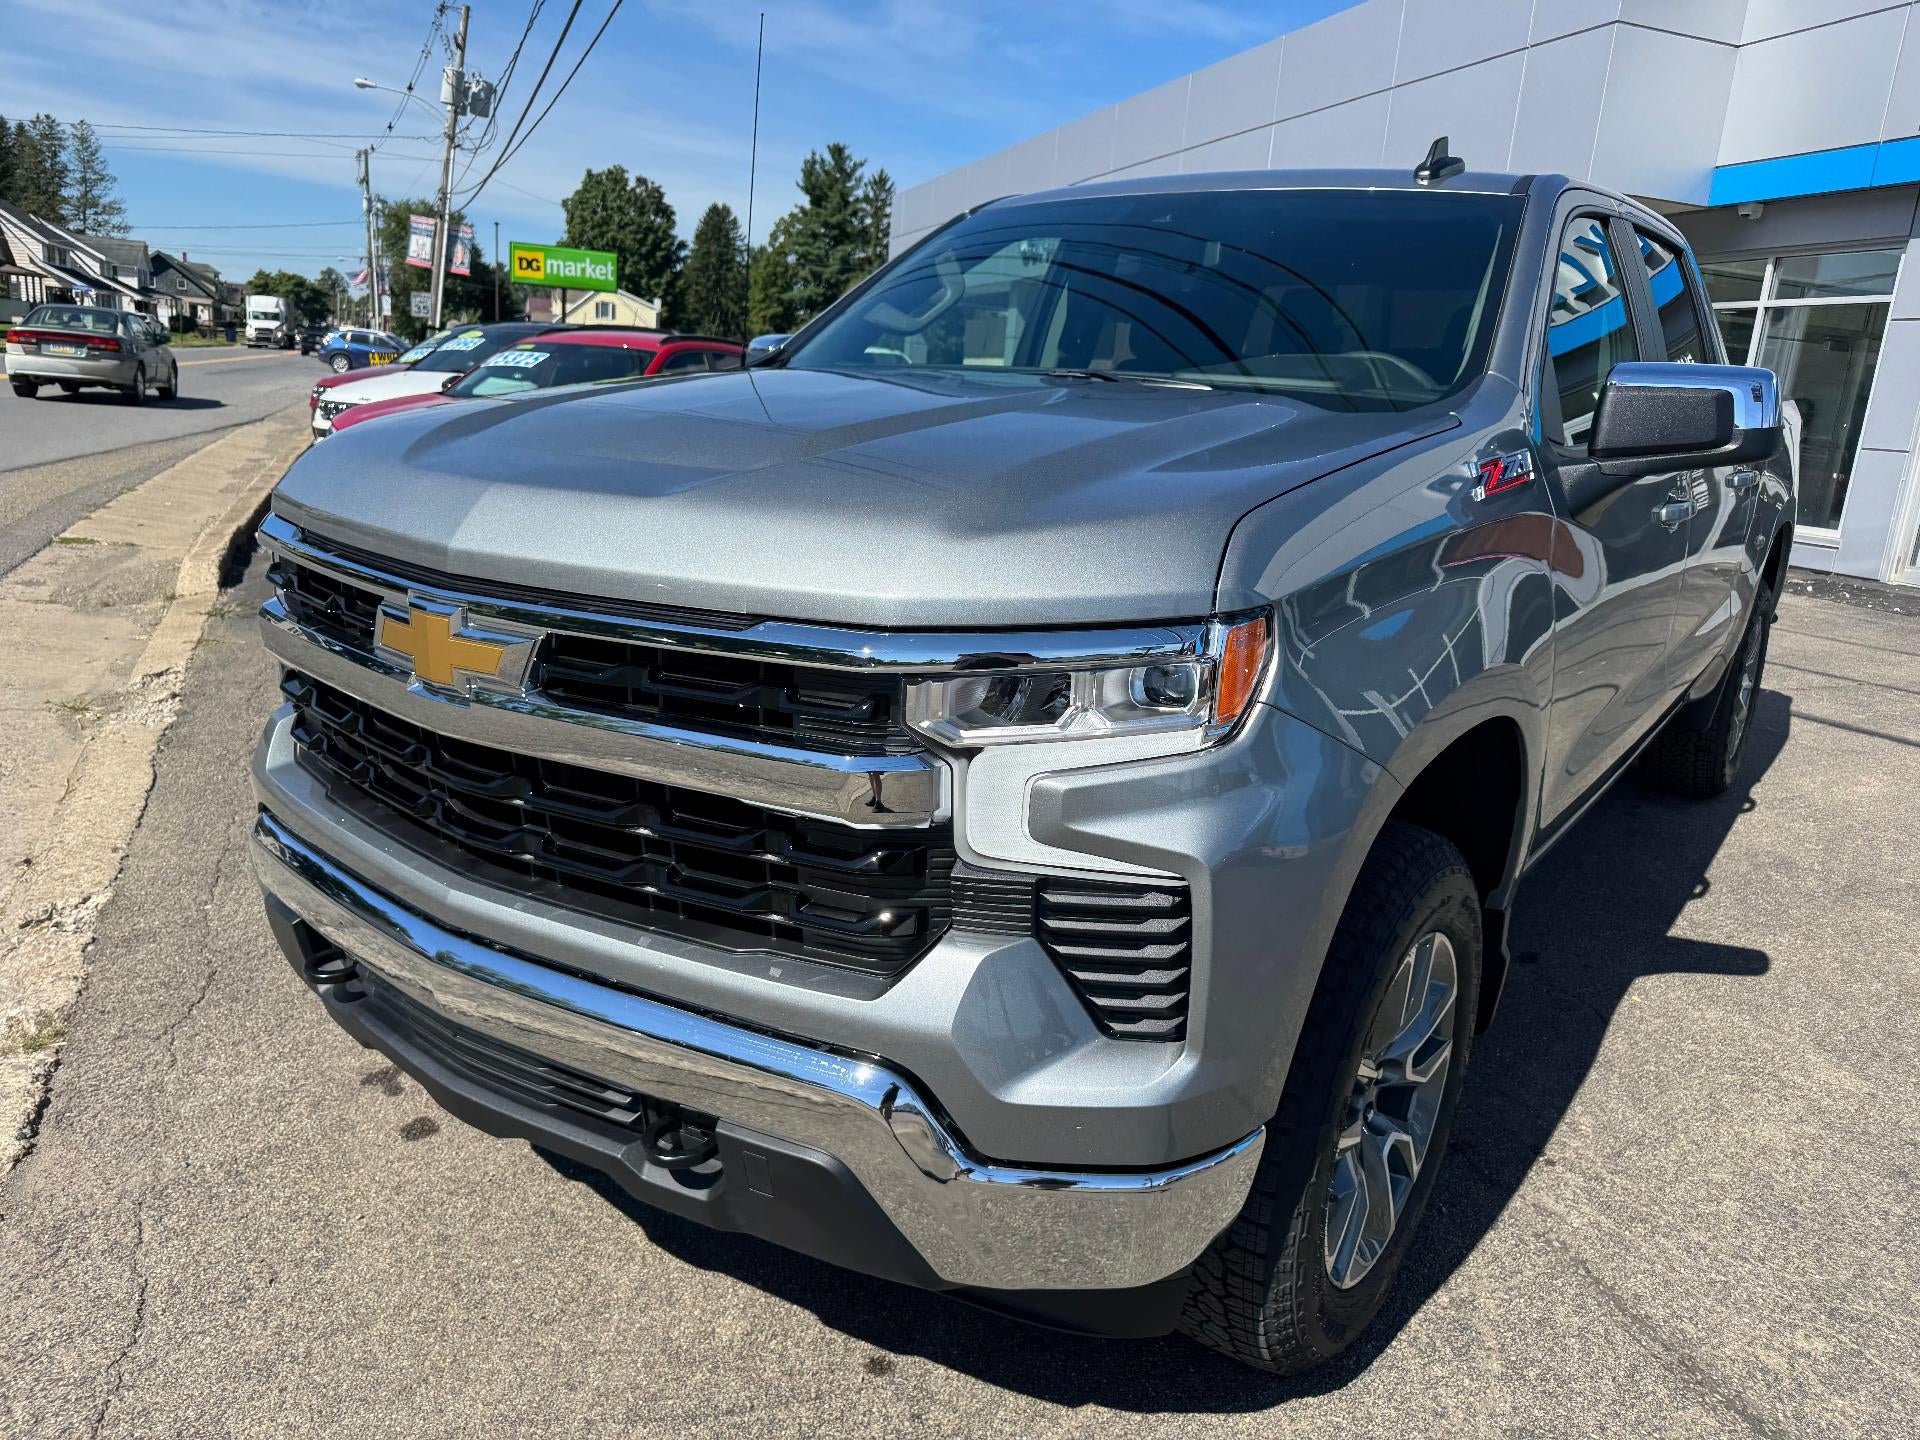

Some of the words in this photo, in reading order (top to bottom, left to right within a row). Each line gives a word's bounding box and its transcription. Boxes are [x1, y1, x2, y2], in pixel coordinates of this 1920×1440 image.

[518, 256, 542, 272] DG
[546, 258, 614, 281] market
[414, 303, 430, 315] 35
